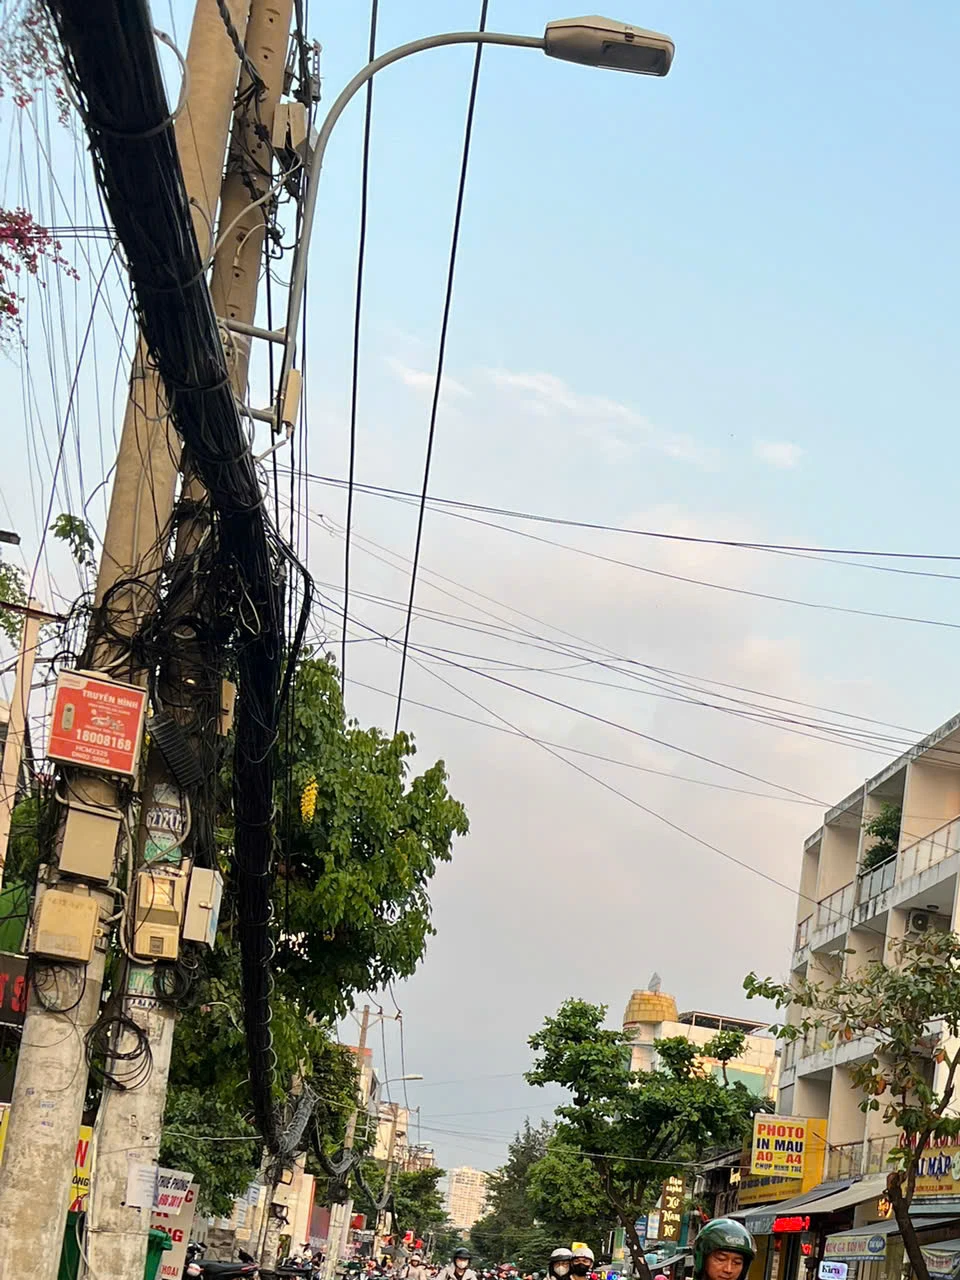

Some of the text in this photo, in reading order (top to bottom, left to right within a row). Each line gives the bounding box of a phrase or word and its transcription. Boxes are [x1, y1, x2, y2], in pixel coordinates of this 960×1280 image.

[76, 728, 132, 751] 18008168
[757, 1123, 804, 1139] PHOTO
[756, 1138, 770, 1150] IN
[785, 1154, 802, 1164] A4
